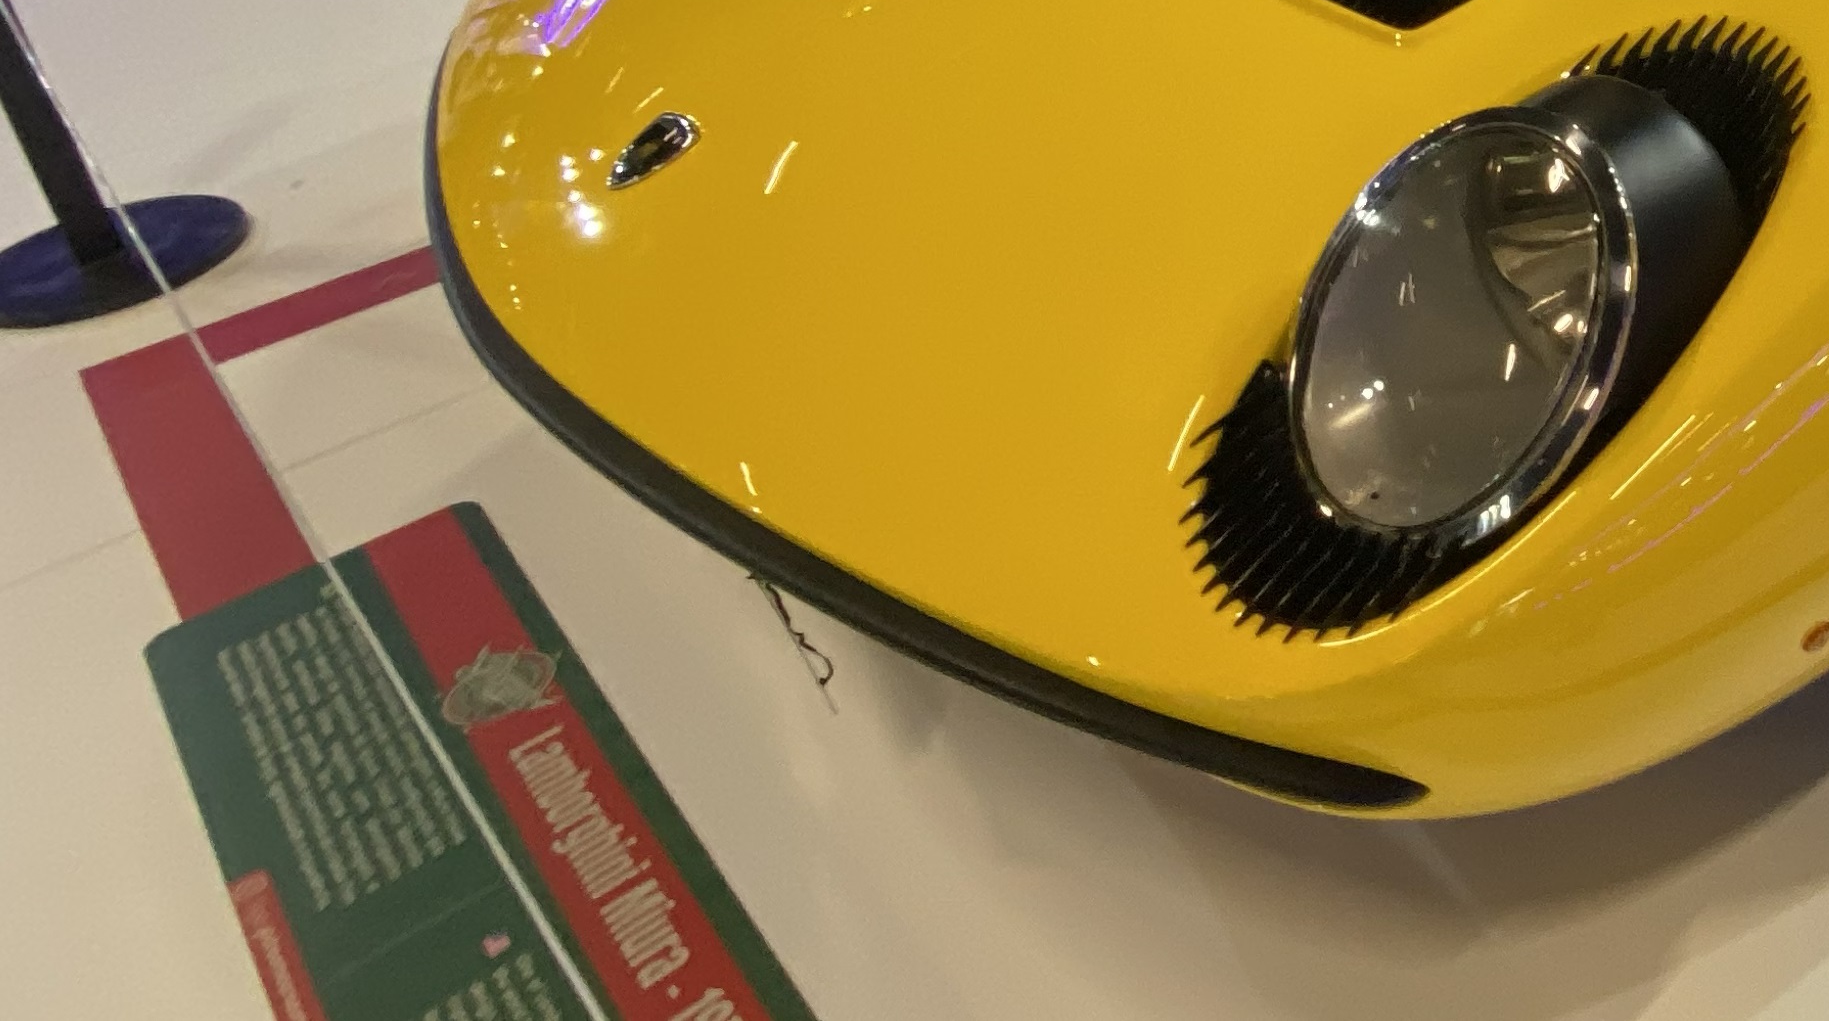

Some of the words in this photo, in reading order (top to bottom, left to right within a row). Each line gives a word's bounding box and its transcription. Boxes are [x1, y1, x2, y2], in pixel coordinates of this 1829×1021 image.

[508, 725, 653, 899] Lamborghini
[600, 878, 690, 990] Miura
[666, 987, 745, 1021] 19
